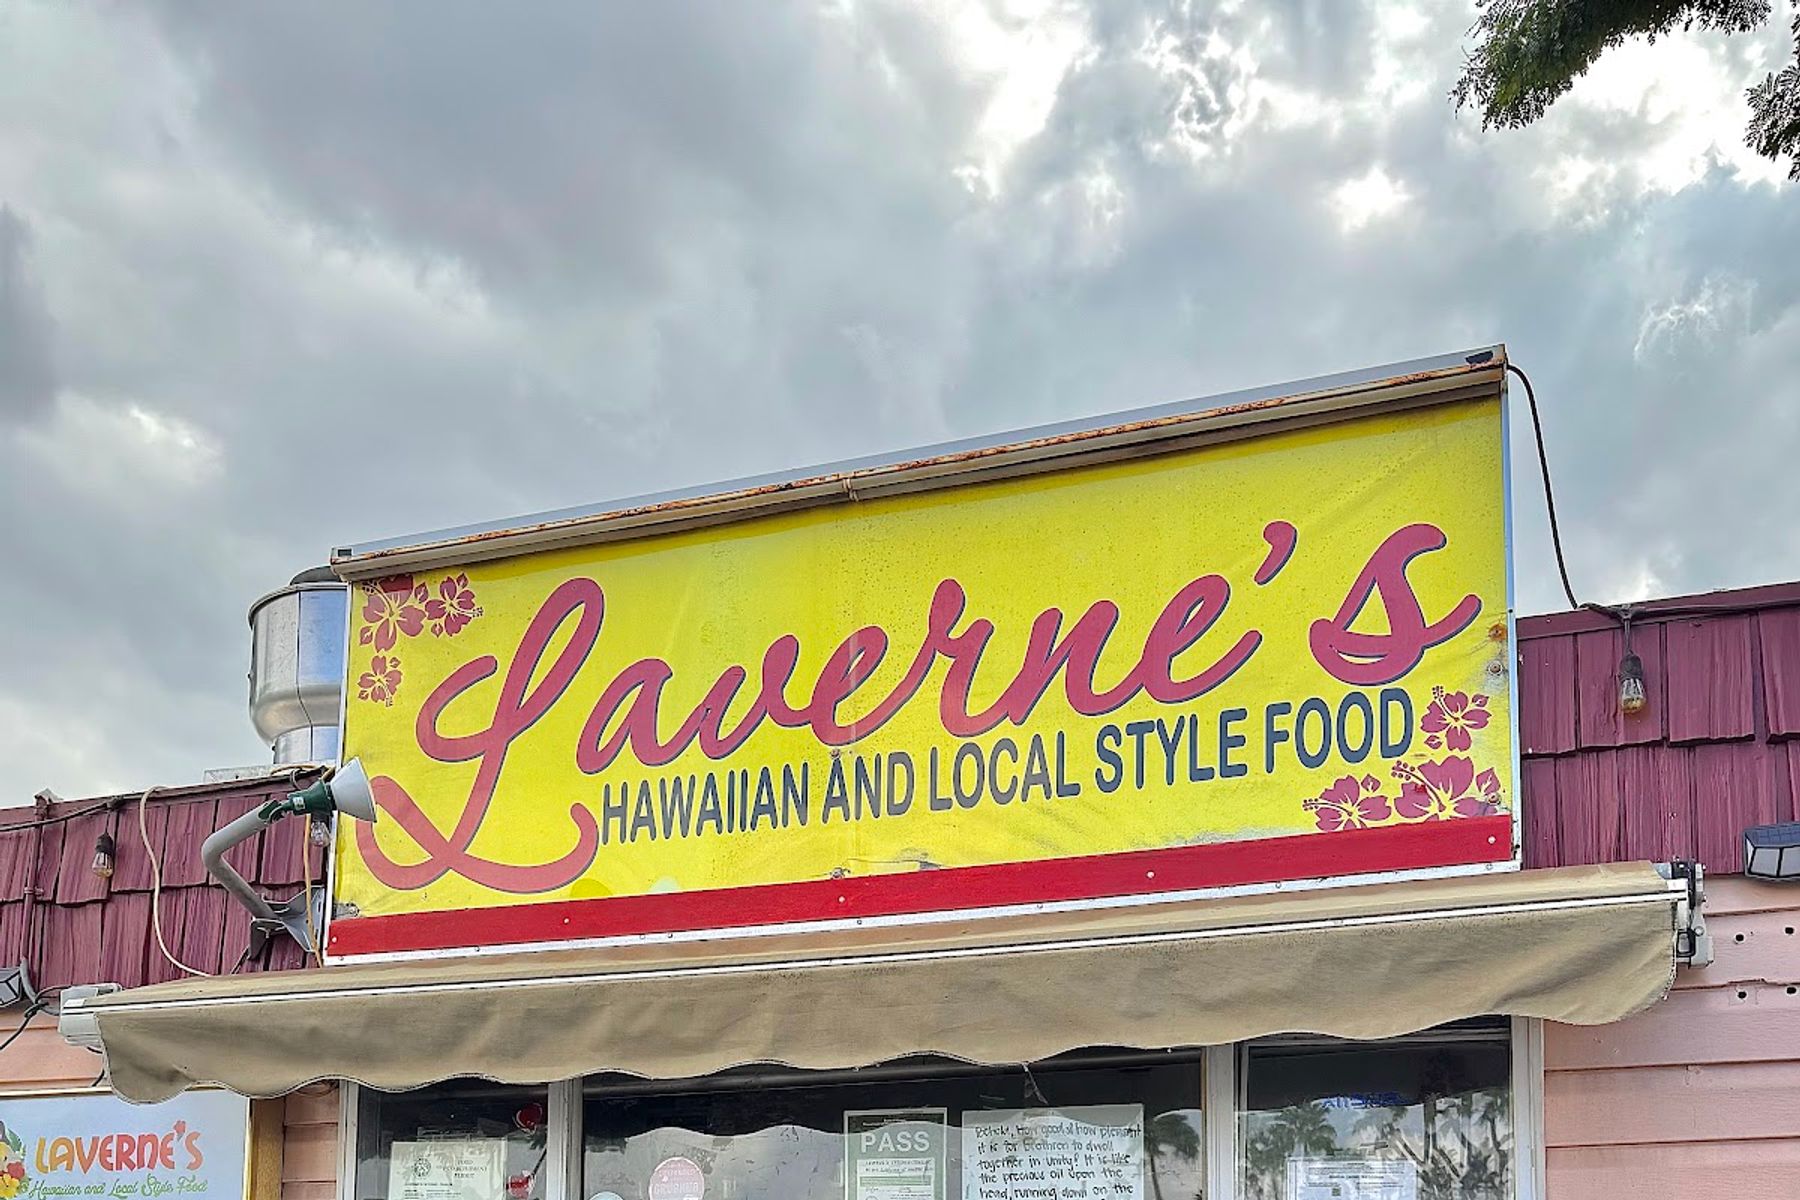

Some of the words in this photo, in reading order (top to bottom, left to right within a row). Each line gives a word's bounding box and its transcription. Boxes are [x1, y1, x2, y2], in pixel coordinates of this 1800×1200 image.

[356, 520, 1483, 893] Laverne's
[601, 761, 809, 846] HAWAIIAN
[822, 751, 914, 824] AND
[929, 730, 1081, 812] LOCAL
[1094, 707, 1247, 794] STYLE
[1265, 687, 1414, 774] FOOD
[35, 1120, 204, 1174] LAVERNE'S
[861, 1131, 930, 1153] PASS
[28, 1179, 82, 1200] Hawaiian
[84, 1181, 105, 1194] and
[108, 1178, 138, 1200] Local
[141, 1173, 174, 1197] Style
[175, 1175, 208, 1194] Food
[979, 1172, 998, 1184] the
[1101, 1167, 1123, 1179] the
[1112, 1183, 1134, 1195] the
